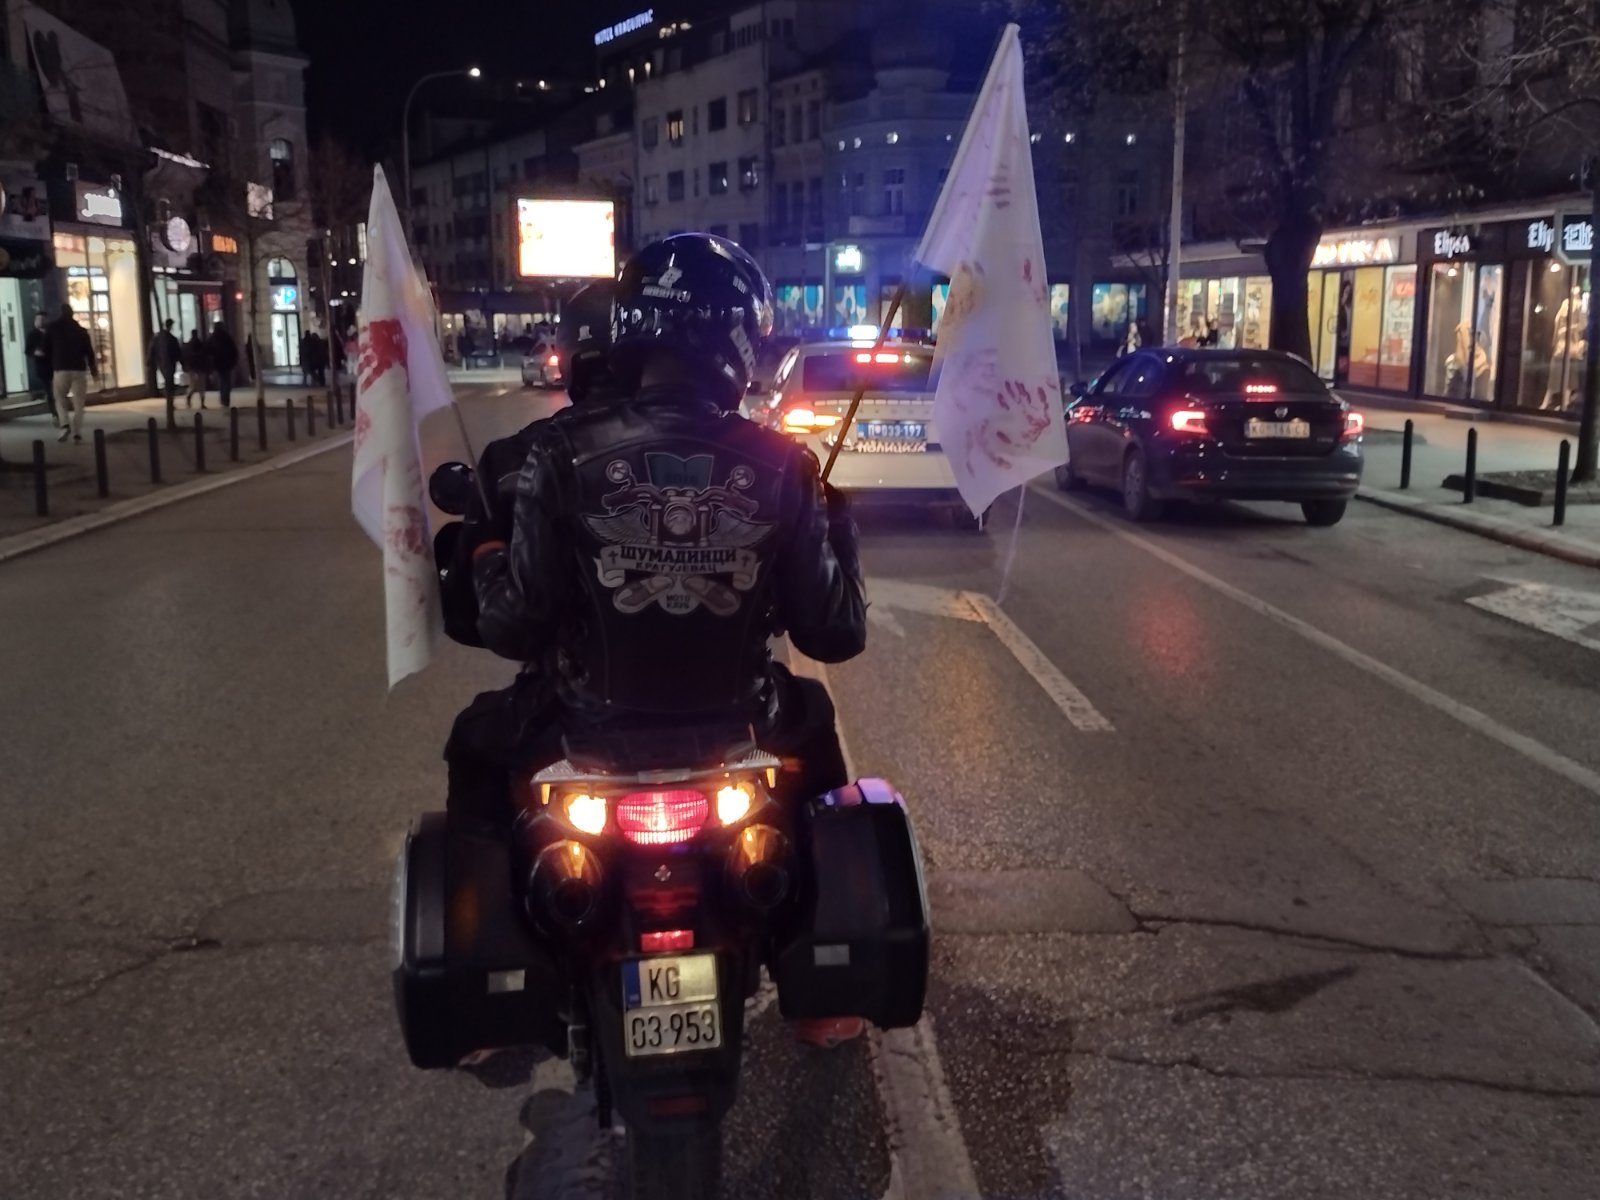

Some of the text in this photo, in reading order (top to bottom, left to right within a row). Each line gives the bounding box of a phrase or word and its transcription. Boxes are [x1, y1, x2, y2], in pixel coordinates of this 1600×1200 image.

[620, 545, 737, 566] ШУМАДИНЦИ
[635, 561, 717, 573] КРАГУЈЕВАЦ
[649, 967, 681, 1001] KG
[632, 1010, 716, 1050] 03-953
